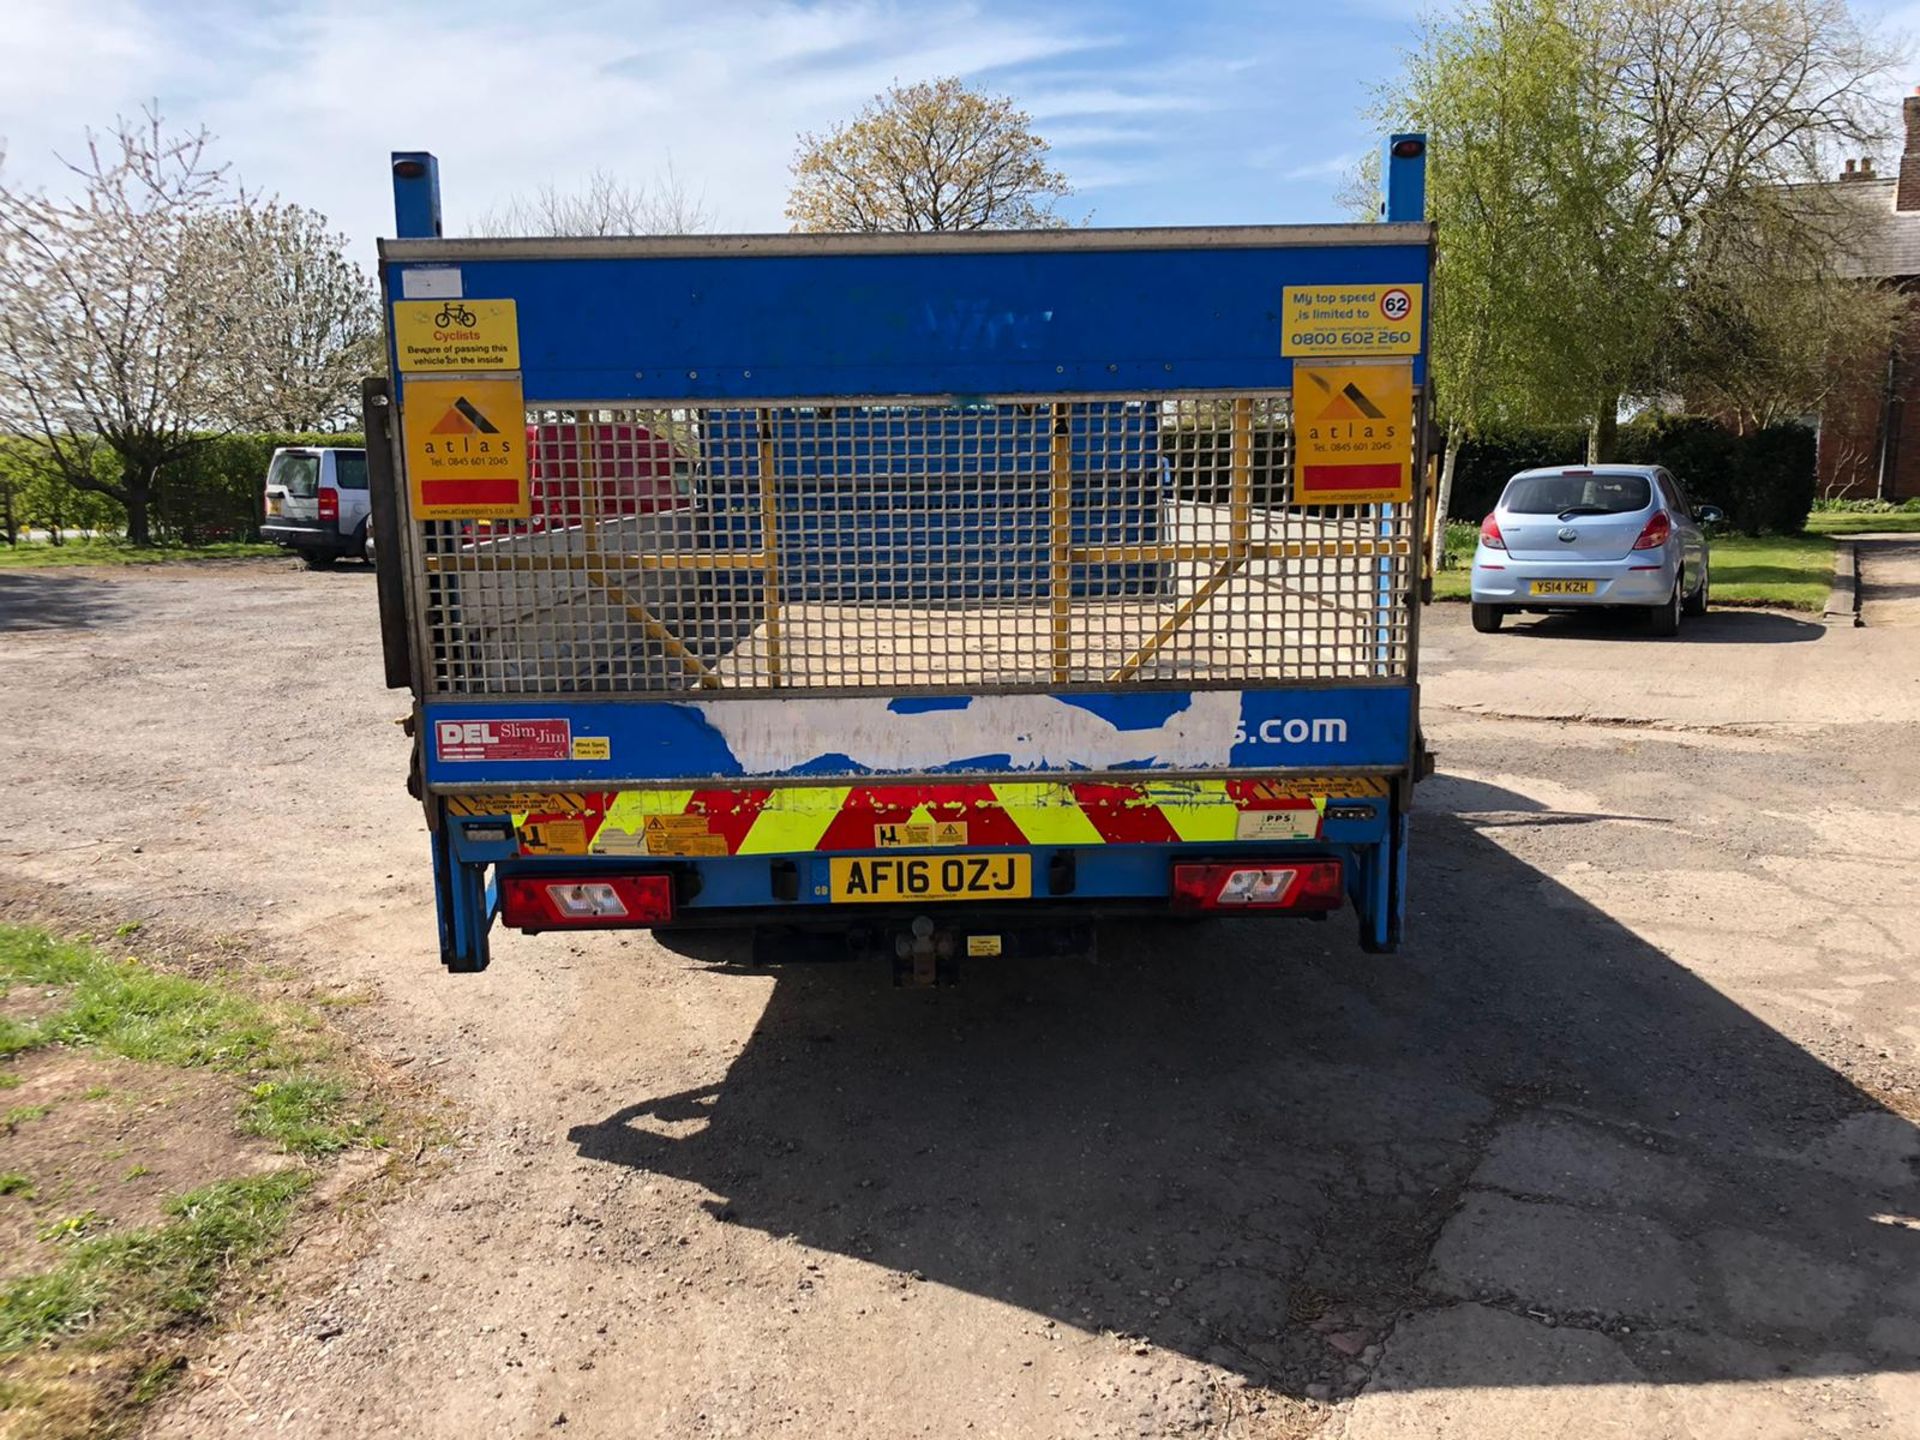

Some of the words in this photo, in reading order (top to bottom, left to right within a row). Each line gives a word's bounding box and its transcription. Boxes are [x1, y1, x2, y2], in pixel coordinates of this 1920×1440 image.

[1293, 293, 1313, 305] My
[1316, 293, 1336, 305] top
[1340, 292, 1376, 304] speed
[1385, 298, 1407, 312] 62
[1298, 310, 1310, 320] is
[1313, 309, 1354, 320] limited
[1357, 309, 1369, 319] to
[433, 331, 481, 343] Cyclists
[1291, 333, 1337, 345] 0800
[1341, 332, 1374, 344] 602
[1378, 331, 1411, 343] 260
[407, 345, 442, 354] Beware
[444, 345, 453, 353] of
[454, 345, 490, 355] passing
[491, 344, 508, 353] this
[413, 357, 445, 365] vehicle
[460, 356, 475, 364] the
[477, 355, 504, 364] inside
[1309, 422, 1395, 440] atlas
[425, 436, 511, 454] atlas
[1330, 442, 1351, 451] 0845
[1353, 442, 1369, 451] 601
[1371, 441, 1392, 450] 2045
[448, 457, 469, 466] 0845
[471, 457, 486, 466] 601
[488, 456, 509, 466] 2045
[1536, 582, 1562, 593] YS14
[1564, 582, 1588, 593] KZH
[440, 723, 500, 745] DEL
[500, 722, 537, 738] Slim
[535, 729, 567, 744] Jim
[1266, 814, 1291, 823] PPS
[846, 860, 930, 895] AF16
[941, 858, 1015, 893] OZJ
[814, 885, 829, 897] GB
